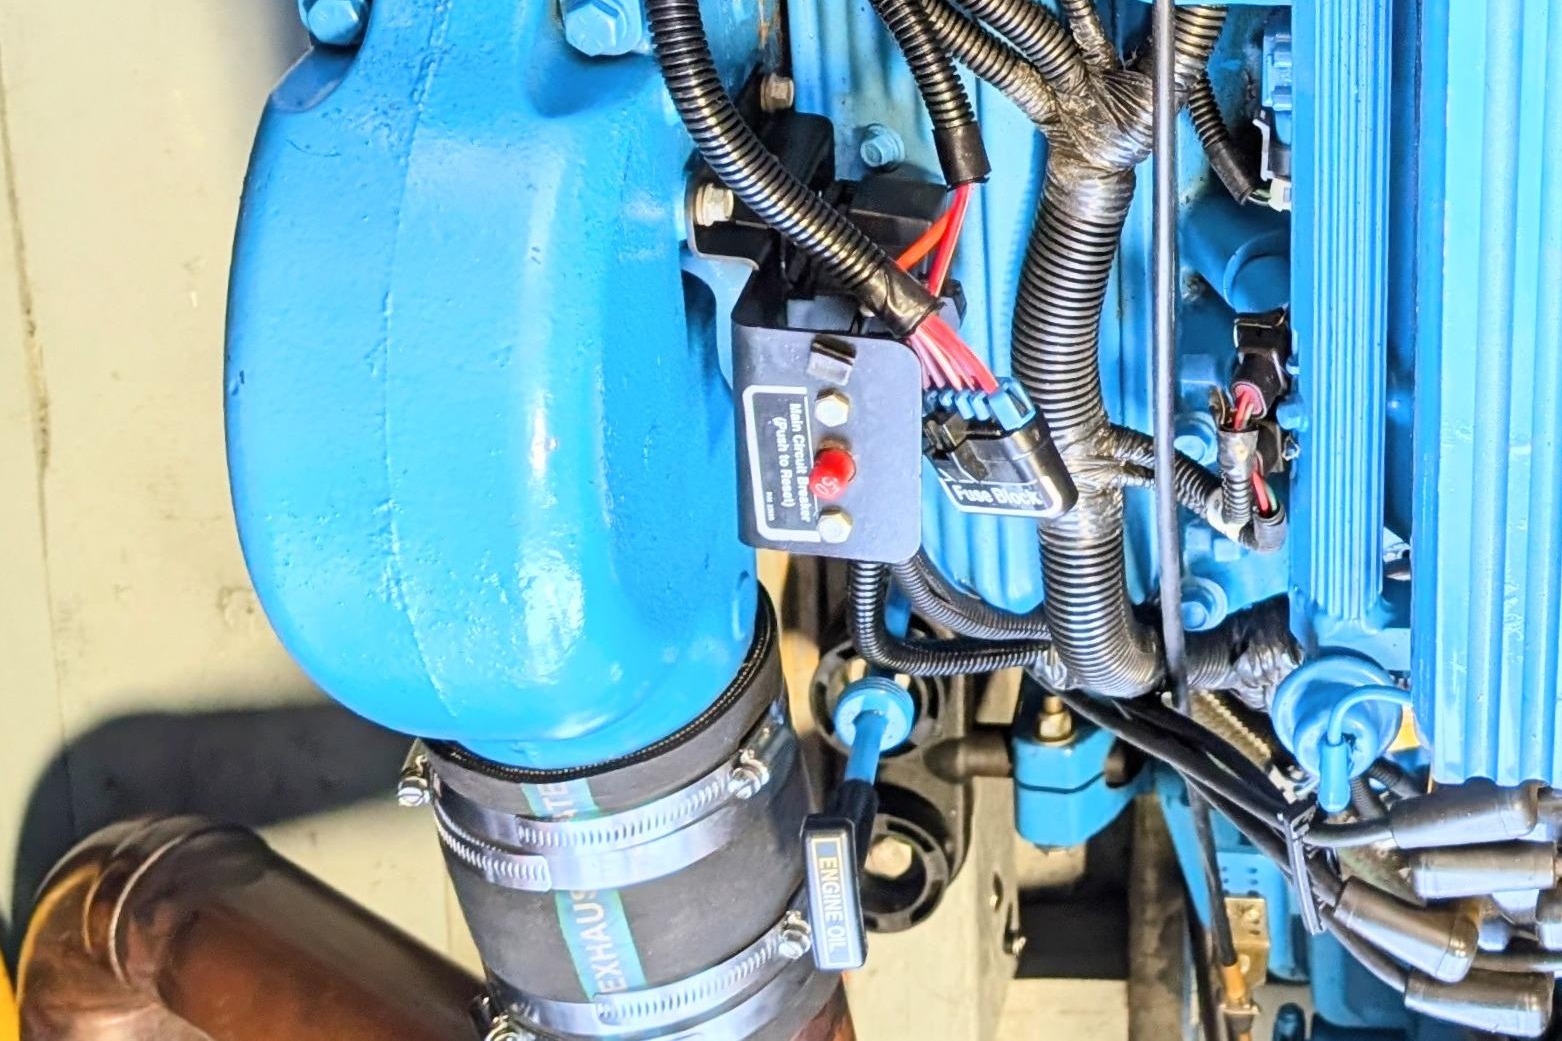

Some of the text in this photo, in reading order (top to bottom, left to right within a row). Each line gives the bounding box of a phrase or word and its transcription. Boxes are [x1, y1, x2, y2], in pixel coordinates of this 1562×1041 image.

[773, 416, 794, 507] (Push to Reset)
[789, 403, 811, 522] Main Circuit Breaker
[951, 484, 1042, 507] Fuse Block
[568, 883, 628, 995] EXHAUS
[818, 857, 846, 952] ENGINE OIL
